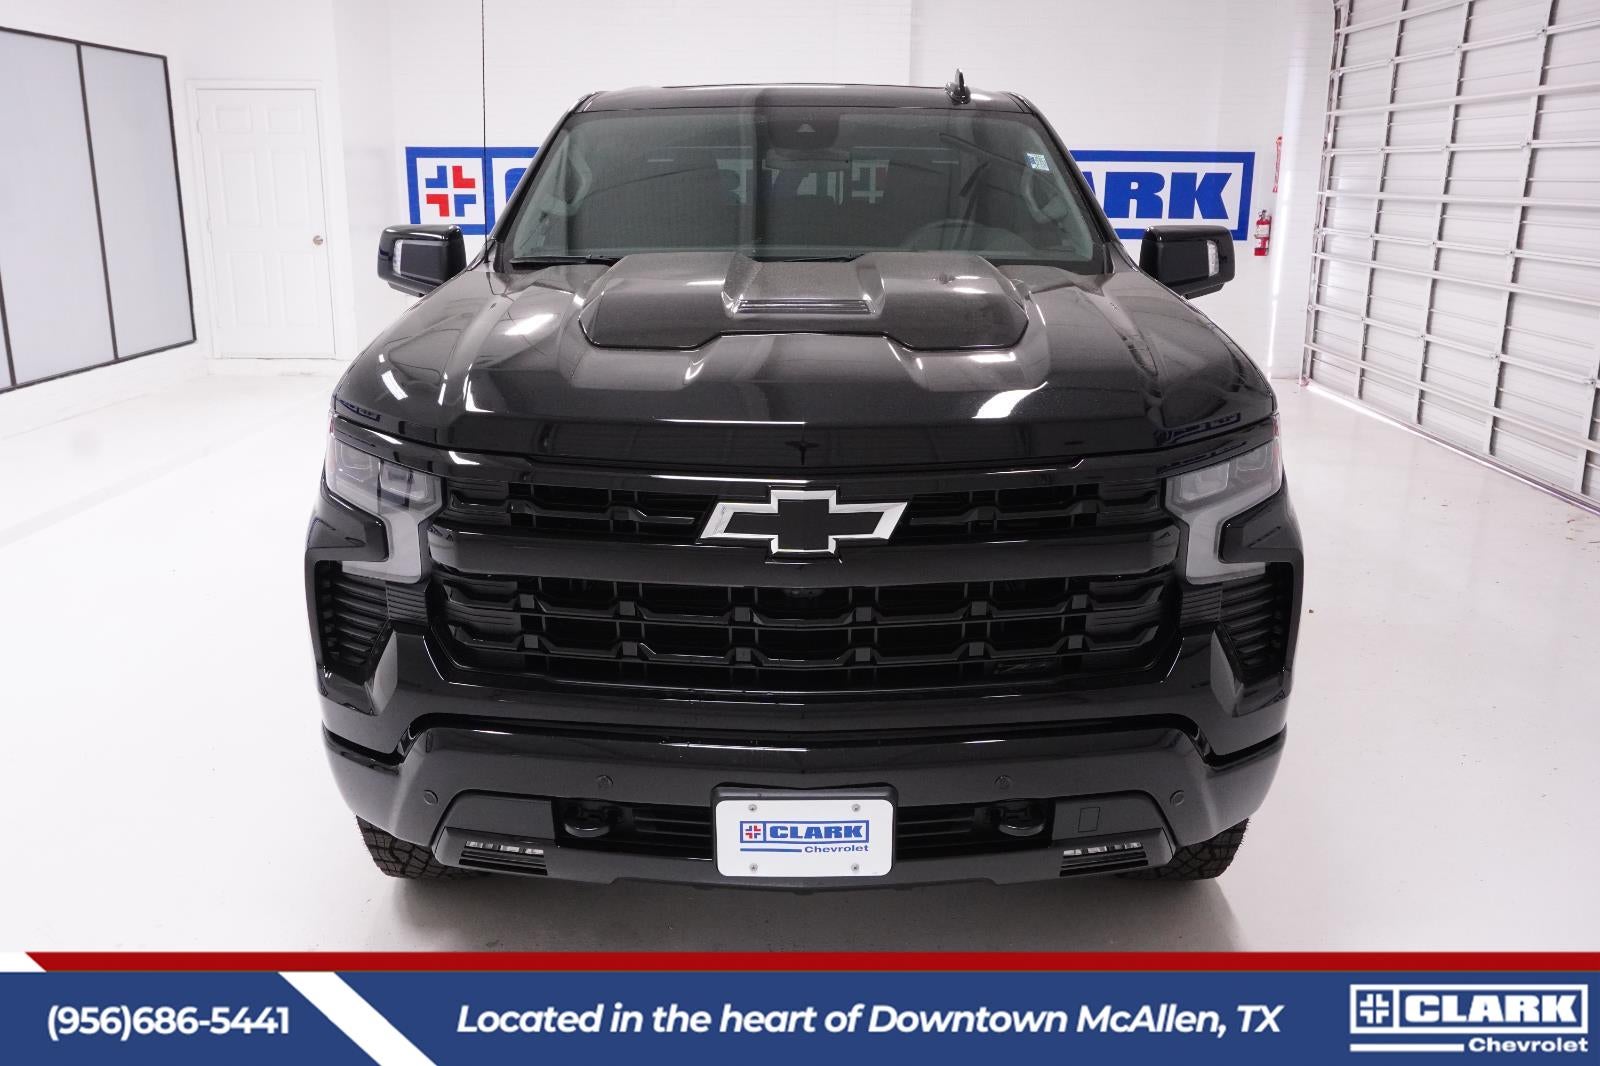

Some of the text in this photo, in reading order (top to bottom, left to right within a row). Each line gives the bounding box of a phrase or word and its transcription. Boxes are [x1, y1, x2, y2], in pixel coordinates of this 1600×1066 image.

[1081, 171, 1233, 219] RK
[769, 825, 863, 839] CLARK
[804, 844, 869, 854] Chevrolet
